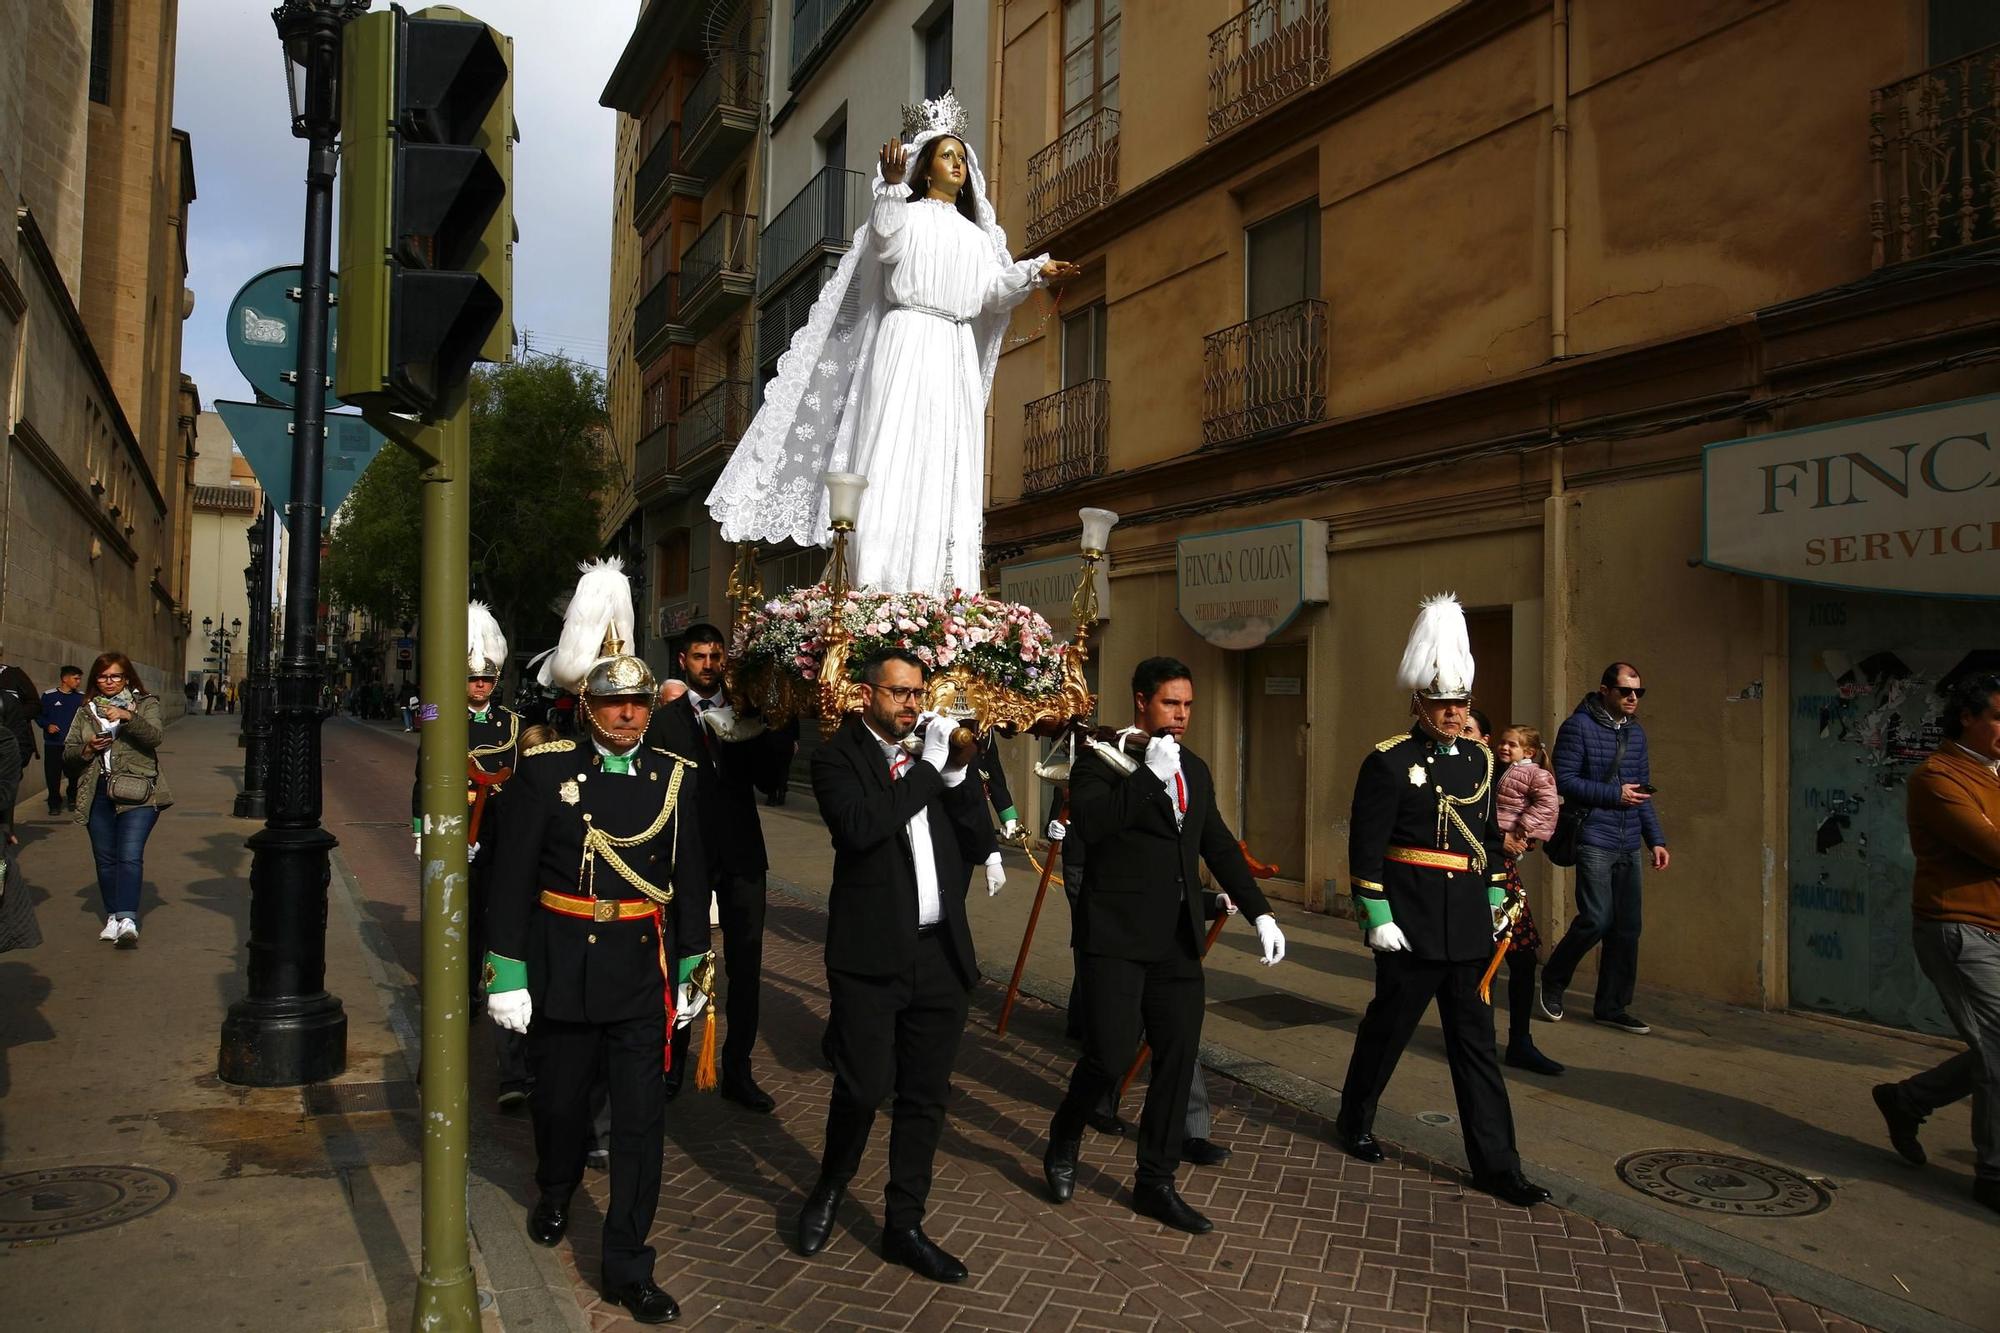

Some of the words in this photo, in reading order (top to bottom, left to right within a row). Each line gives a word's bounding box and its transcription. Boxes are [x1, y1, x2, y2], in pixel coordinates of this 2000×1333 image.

[1758, 432, 2000, 515] FINC
[1184, 550, 1233, 588] FINCAS
[1239, 544, 1293, 583] COLON
